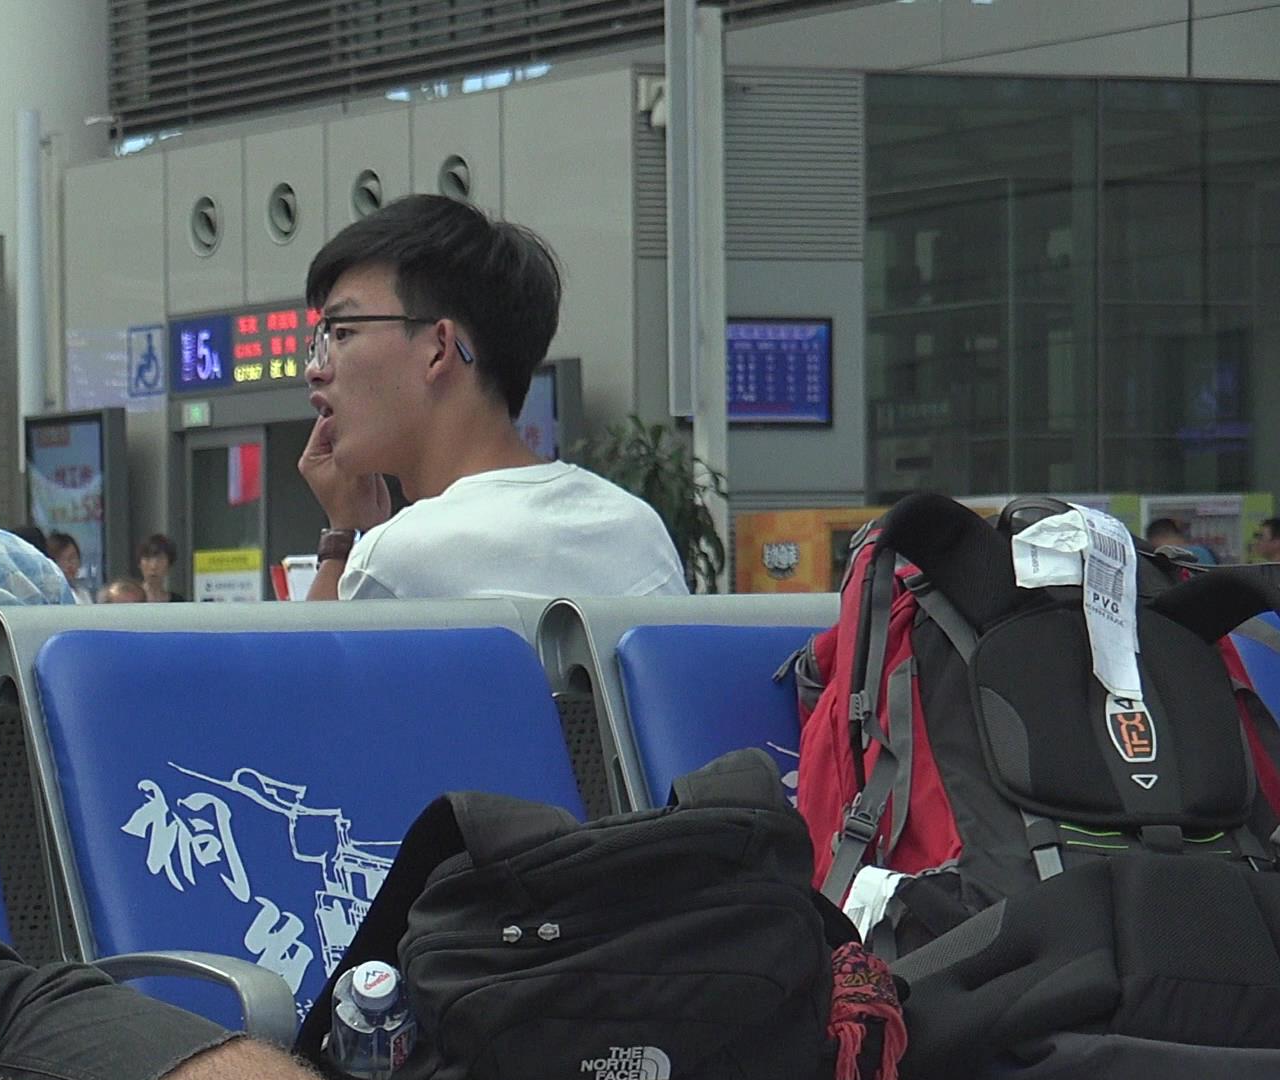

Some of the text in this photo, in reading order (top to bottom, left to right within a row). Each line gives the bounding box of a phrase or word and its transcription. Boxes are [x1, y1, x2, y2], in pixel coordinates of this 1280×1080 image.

[1092, 592, 1120, 614] PVG
[609, 1046, 643, 1060] THE
[580, 1058, 642, 1073] NORTH
